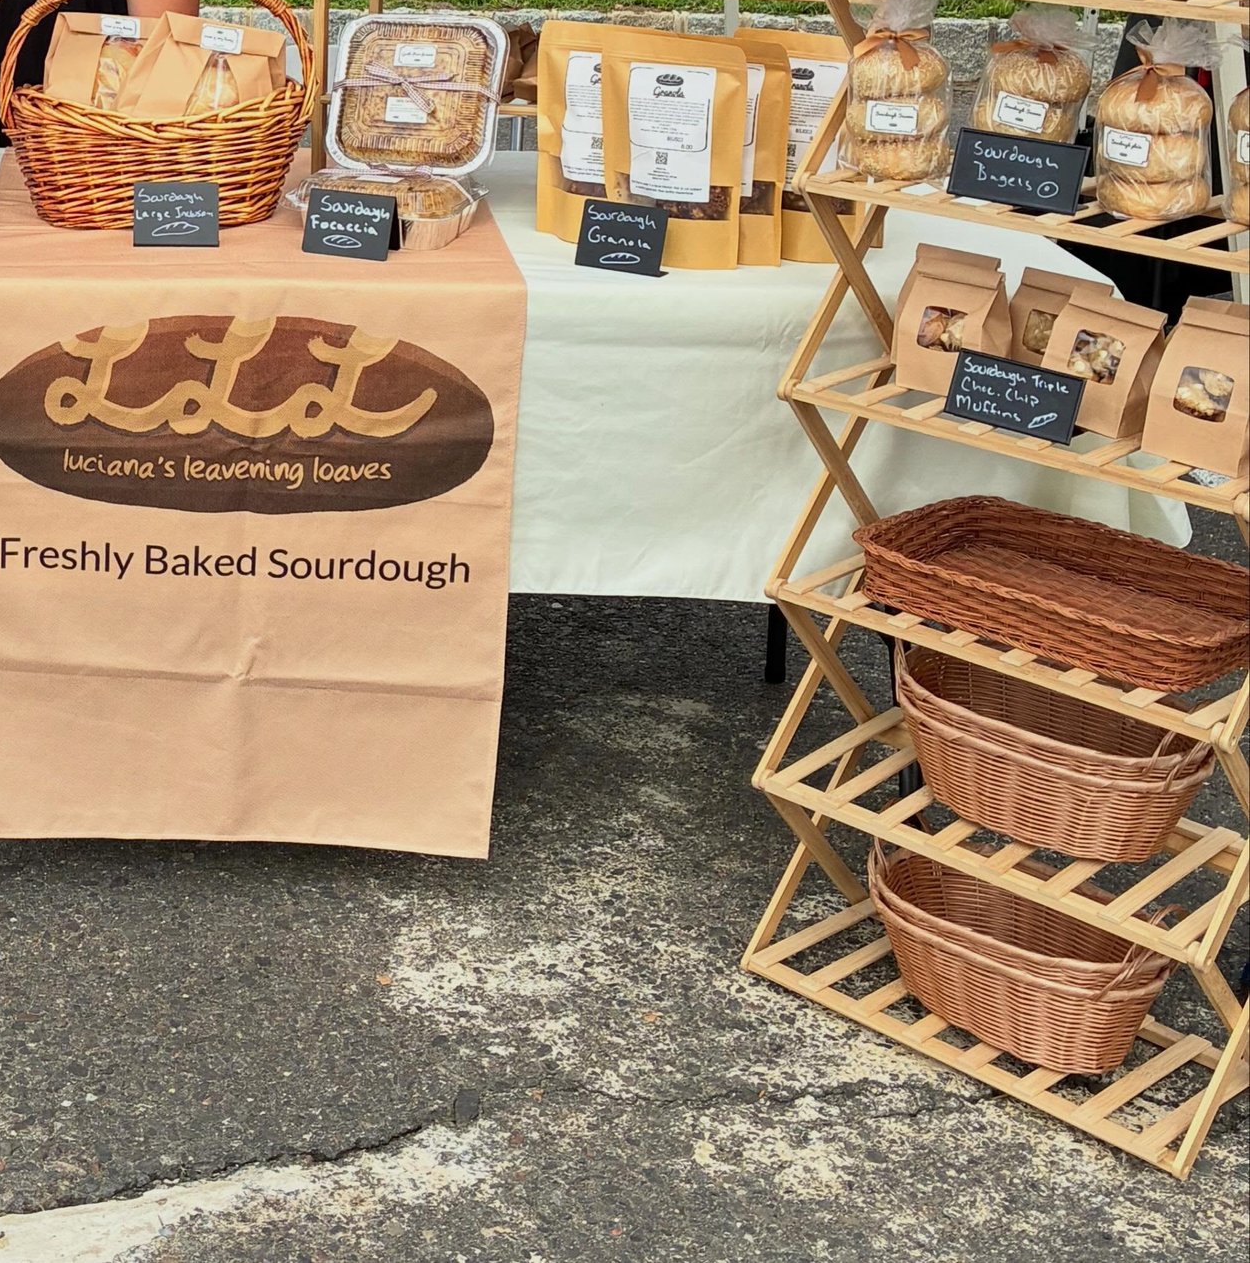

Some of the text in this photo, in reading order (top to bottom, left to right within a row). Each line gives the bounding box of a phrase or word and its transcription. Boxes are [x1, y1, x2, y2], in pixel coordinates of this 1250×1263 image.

[653, 86, 686, 98] Granola
[973, 140, 1059, 170] Sourdough
[973, 160, 1033, 191] Bagels
[138, 188, 204, 204] Sourdough
[320, 195, 390, 222] Sourdough
[135, 209, 171, 221] Large
[310, 214, 379, 236] Focaccia
[588, 204, 657, 230] Sourdough
[587, 225, 652, 250] Granola
[963, 356, 1070, 394] Sourdough Triple
[956, 394, 1022, 422] Muffins
[1005, 388, 1040, 407] Chip
[62, 448, 392, 490] luciana's leavening loaves
[0, 537, 471, 590] Freshly Baked Sourdough
